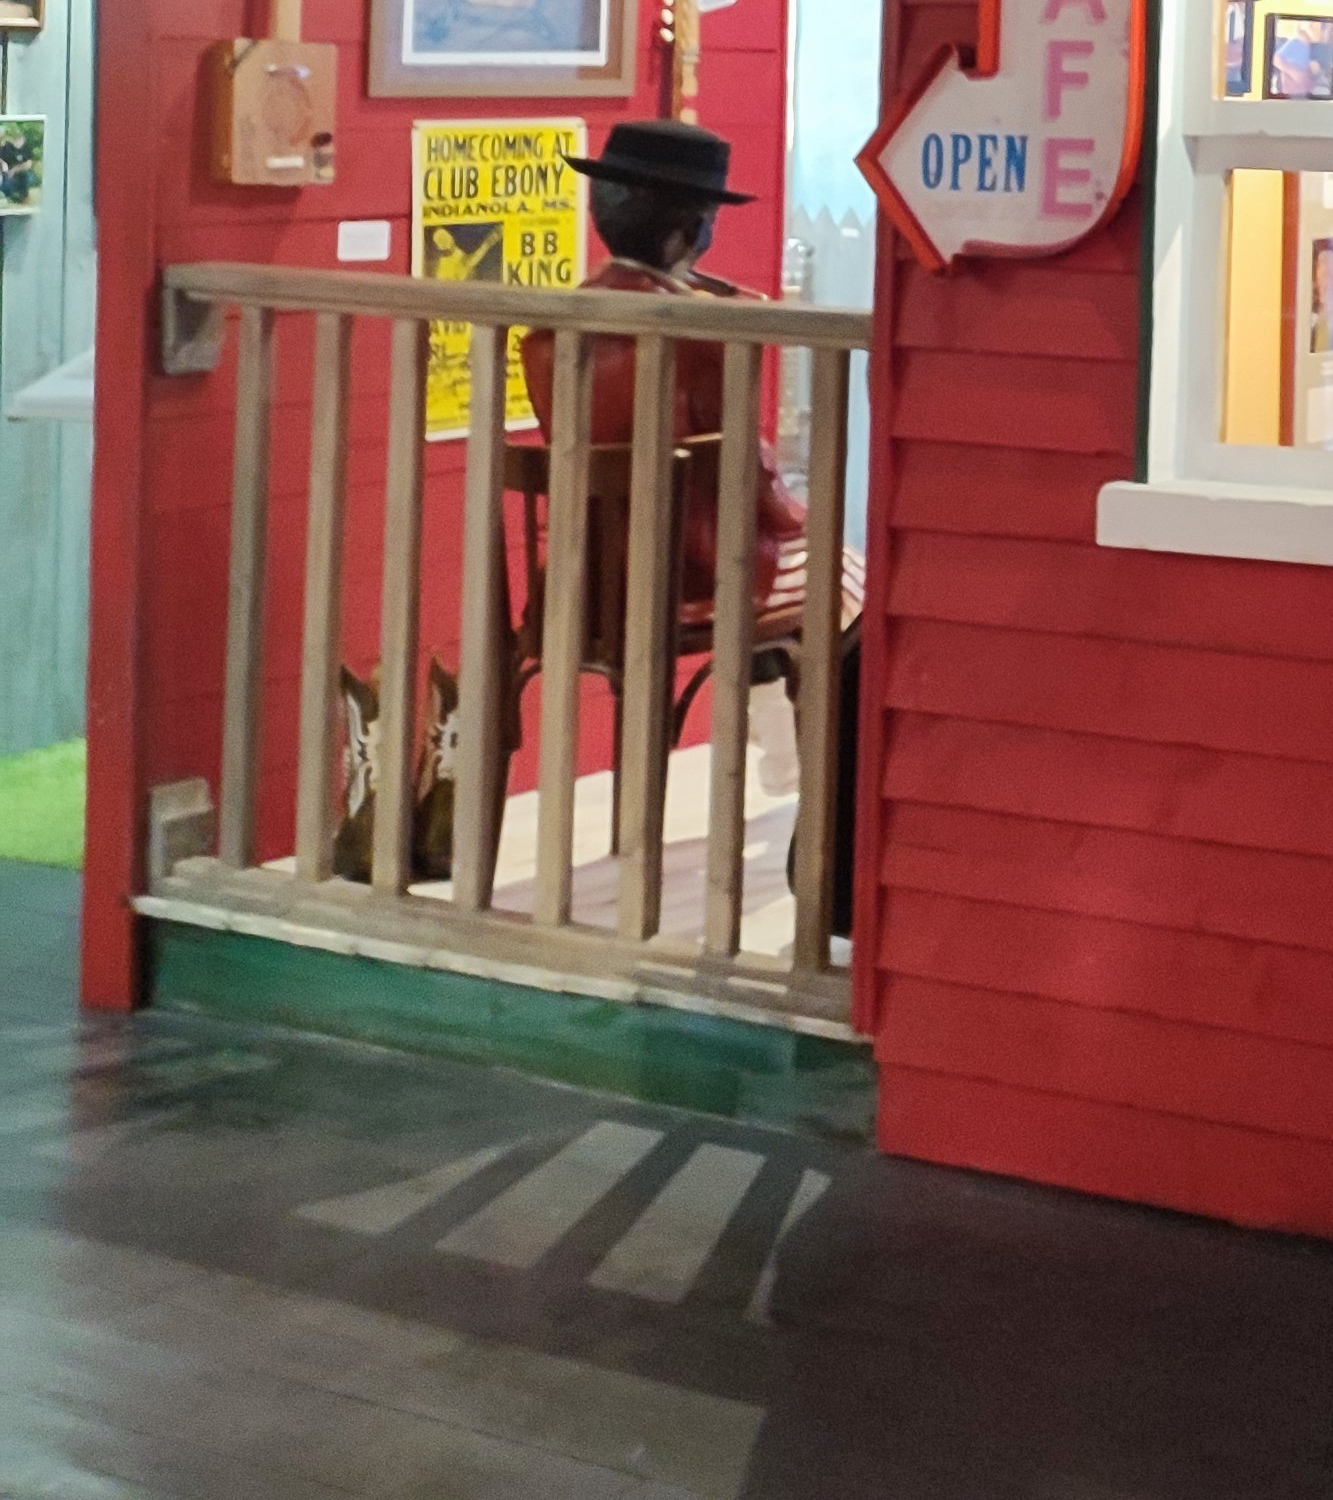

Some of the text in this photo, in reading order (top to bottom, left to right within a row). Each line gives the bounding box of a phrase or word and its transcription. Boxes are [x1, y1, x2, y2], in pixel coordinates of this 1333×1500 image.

[427, 131, 574, 163] HOMECOMING AT
[921, 132, 1029, 193] OPEN
[423, 161, 565, 201] CLUB EBONY
[507, 258, 571, 287] KING
